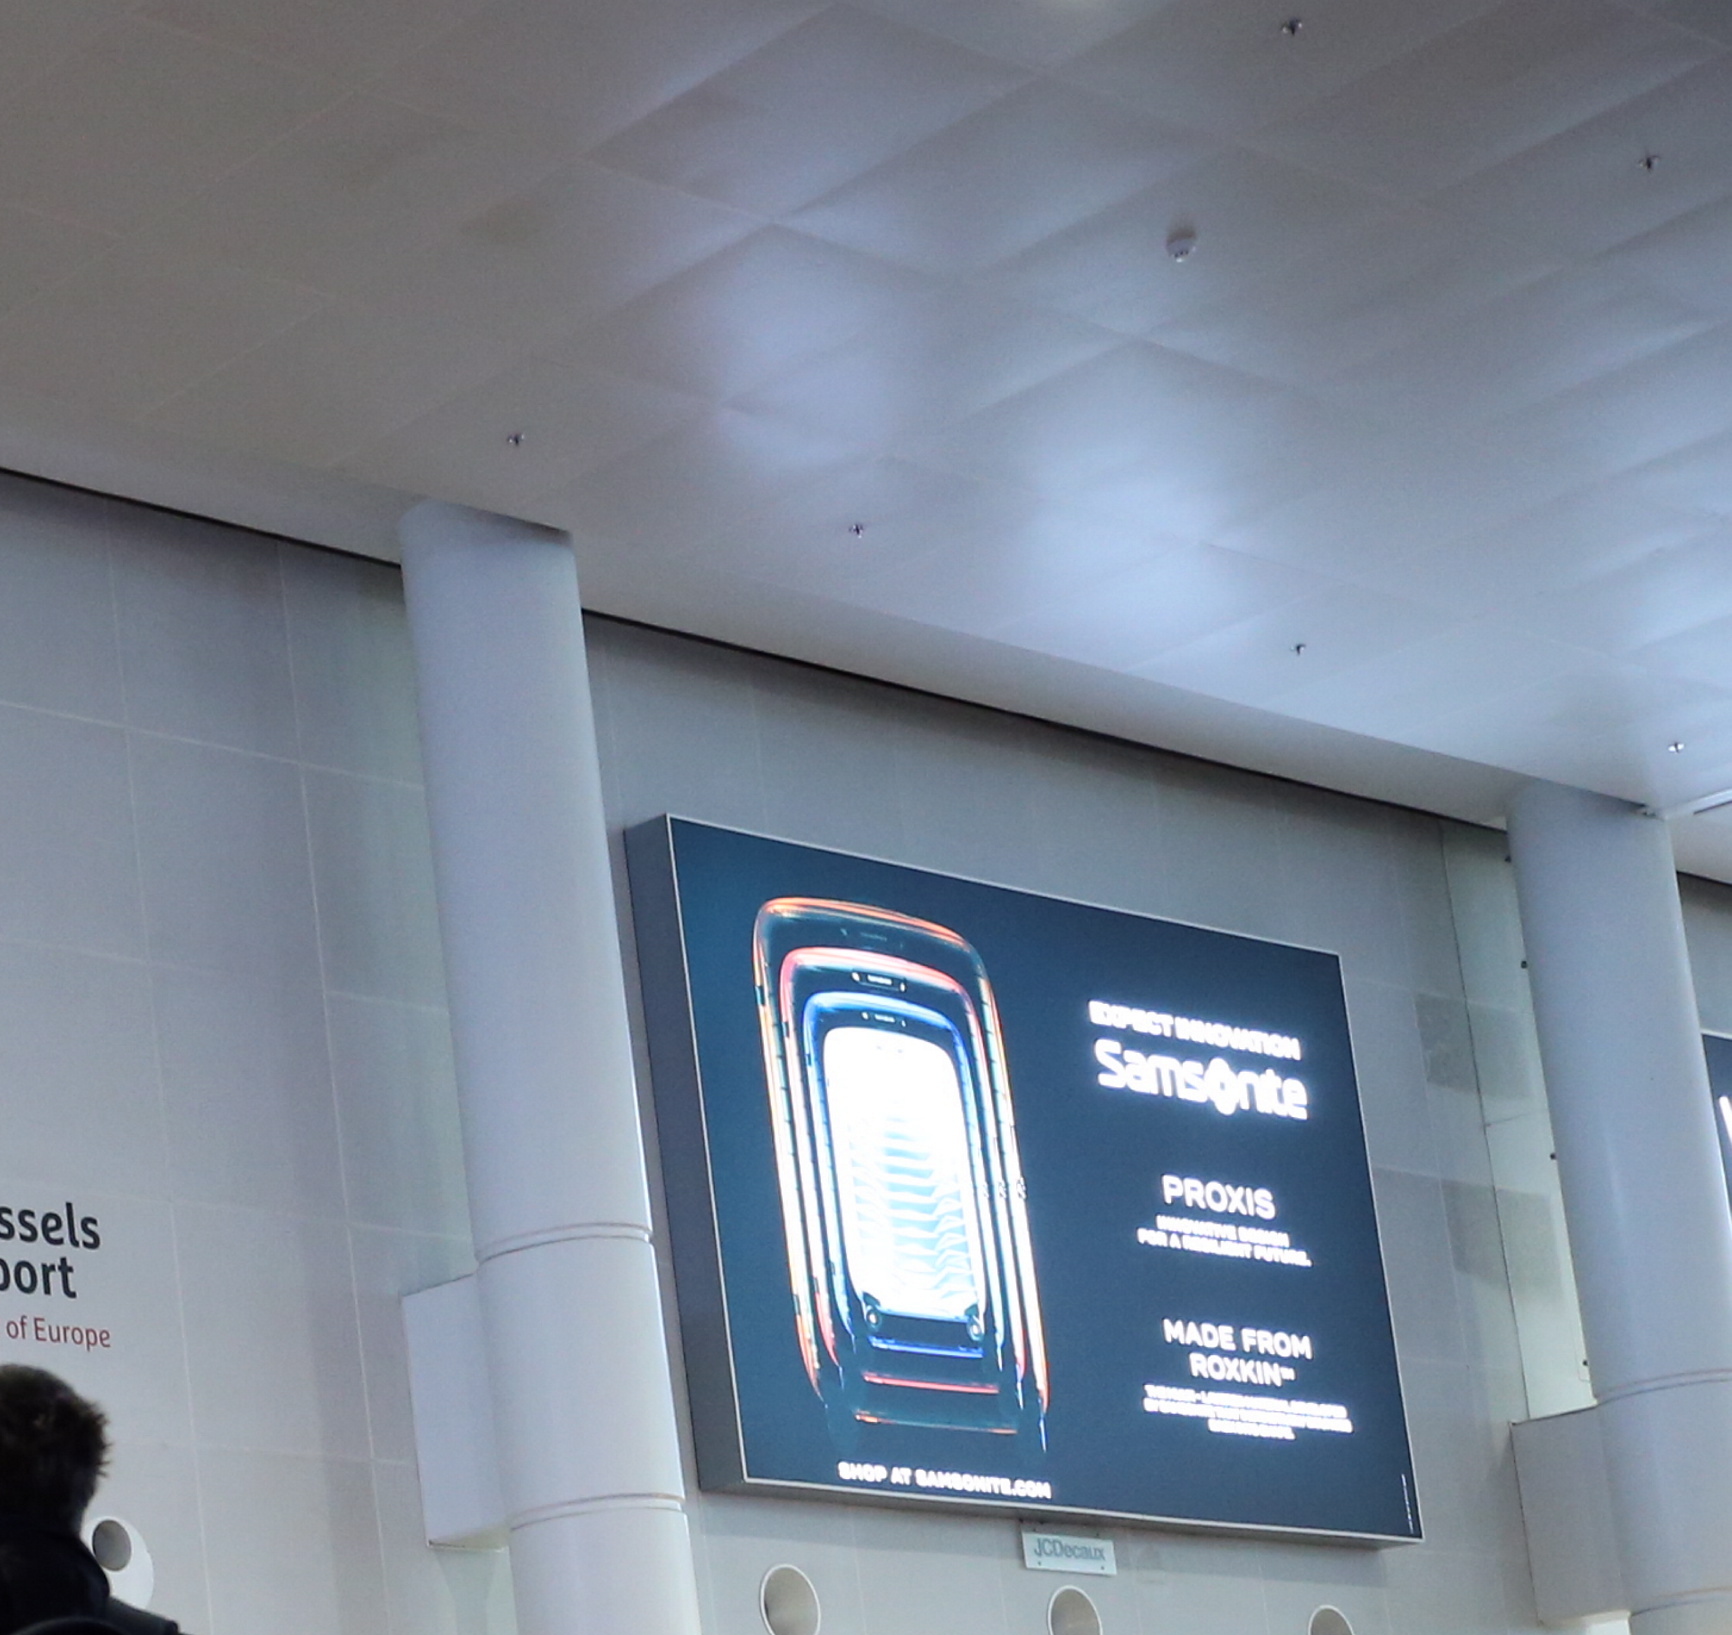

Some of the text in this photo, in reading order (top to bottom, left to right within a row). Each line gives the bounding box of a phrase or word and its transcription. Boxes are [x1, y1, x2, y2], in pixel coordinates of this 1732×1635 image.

[1088, 1000, 1302, 1061] EXPECT INNOVATION
[1094, 1038, 1308, 1120] Samsonite
[1162, 1174, 1276, 1220] PROXIS
[6, 1314, 29, 1340] of
[34, 1318, 111, 1351] Europe
[1162, 1318, 1313, 1359] MADE FROM
[837, 1461, 1052, 1499] SHOP AT SAMSONITE.COM
[1034, 1538, 1106, 1561] JCDecaux
